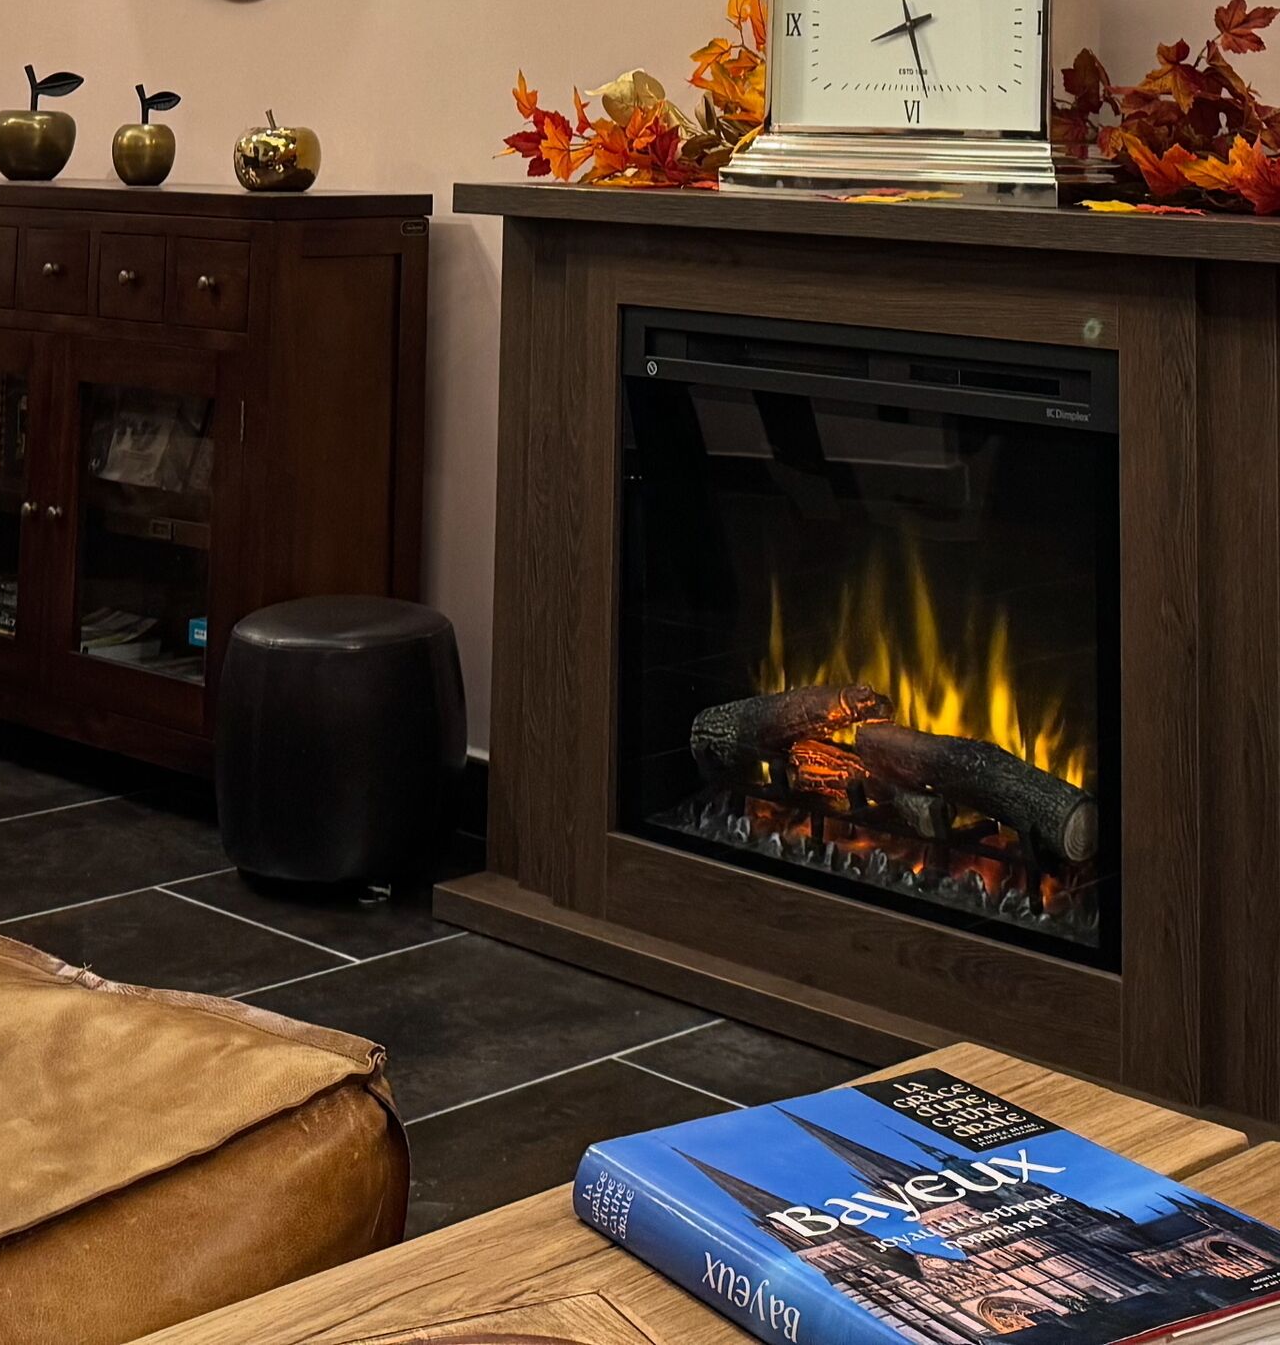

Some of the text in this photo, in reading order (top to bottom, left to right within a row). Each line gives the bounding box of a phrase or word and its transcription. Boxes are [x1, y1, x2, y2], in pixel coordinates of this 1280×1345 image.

[785, 12, 802, 37] IX
[903, 99, 921, 124] VI
[766, 1148, 1067, 1237] Bayeux
[702, 1251, 801, 1344] Bayeux
